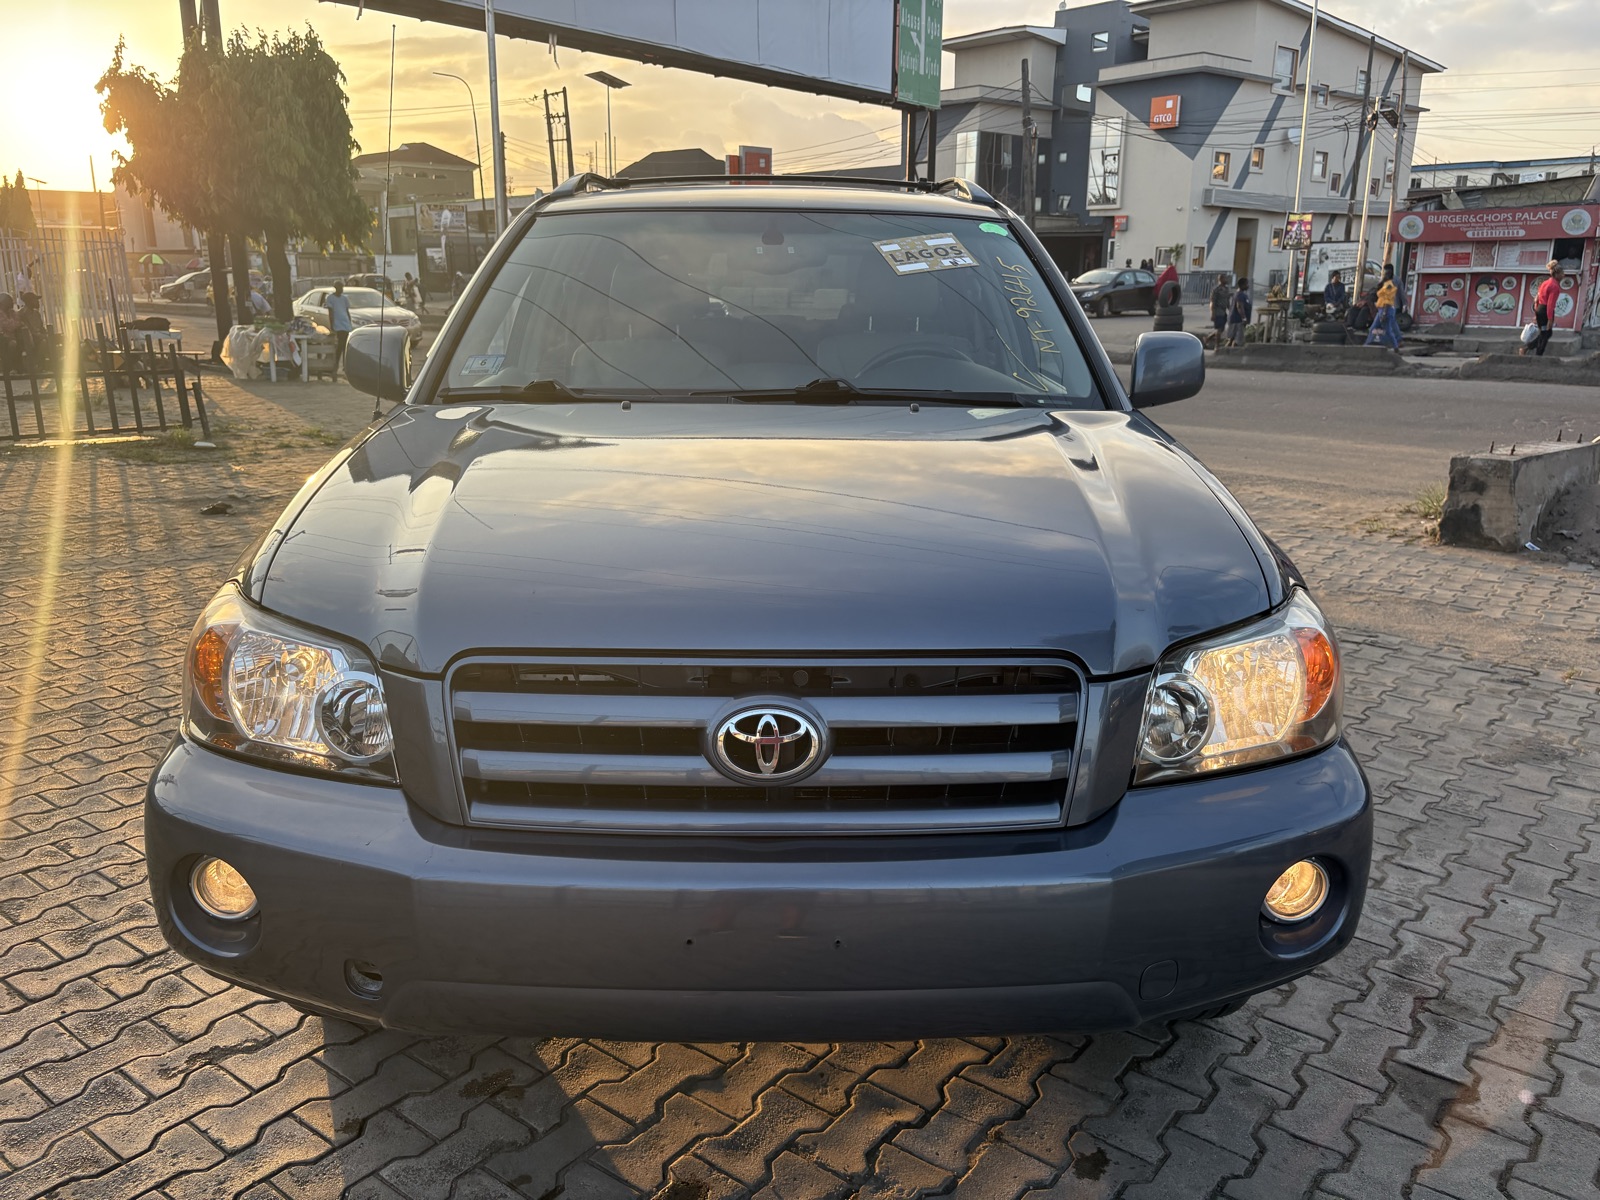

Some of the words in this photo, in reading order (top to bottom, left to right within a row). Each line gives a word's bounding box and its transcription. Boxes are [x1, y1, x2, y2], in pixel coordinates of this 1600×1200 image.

[927, 16, 940, 40] Ogba
[1153, 113, 1172, 123] GTCO
[1427, 213, 1513, 223] BURGER&CHOPS
[1515, 211, 1558, 221] PALACE
[889, 245, 964, 263] LAGOS
